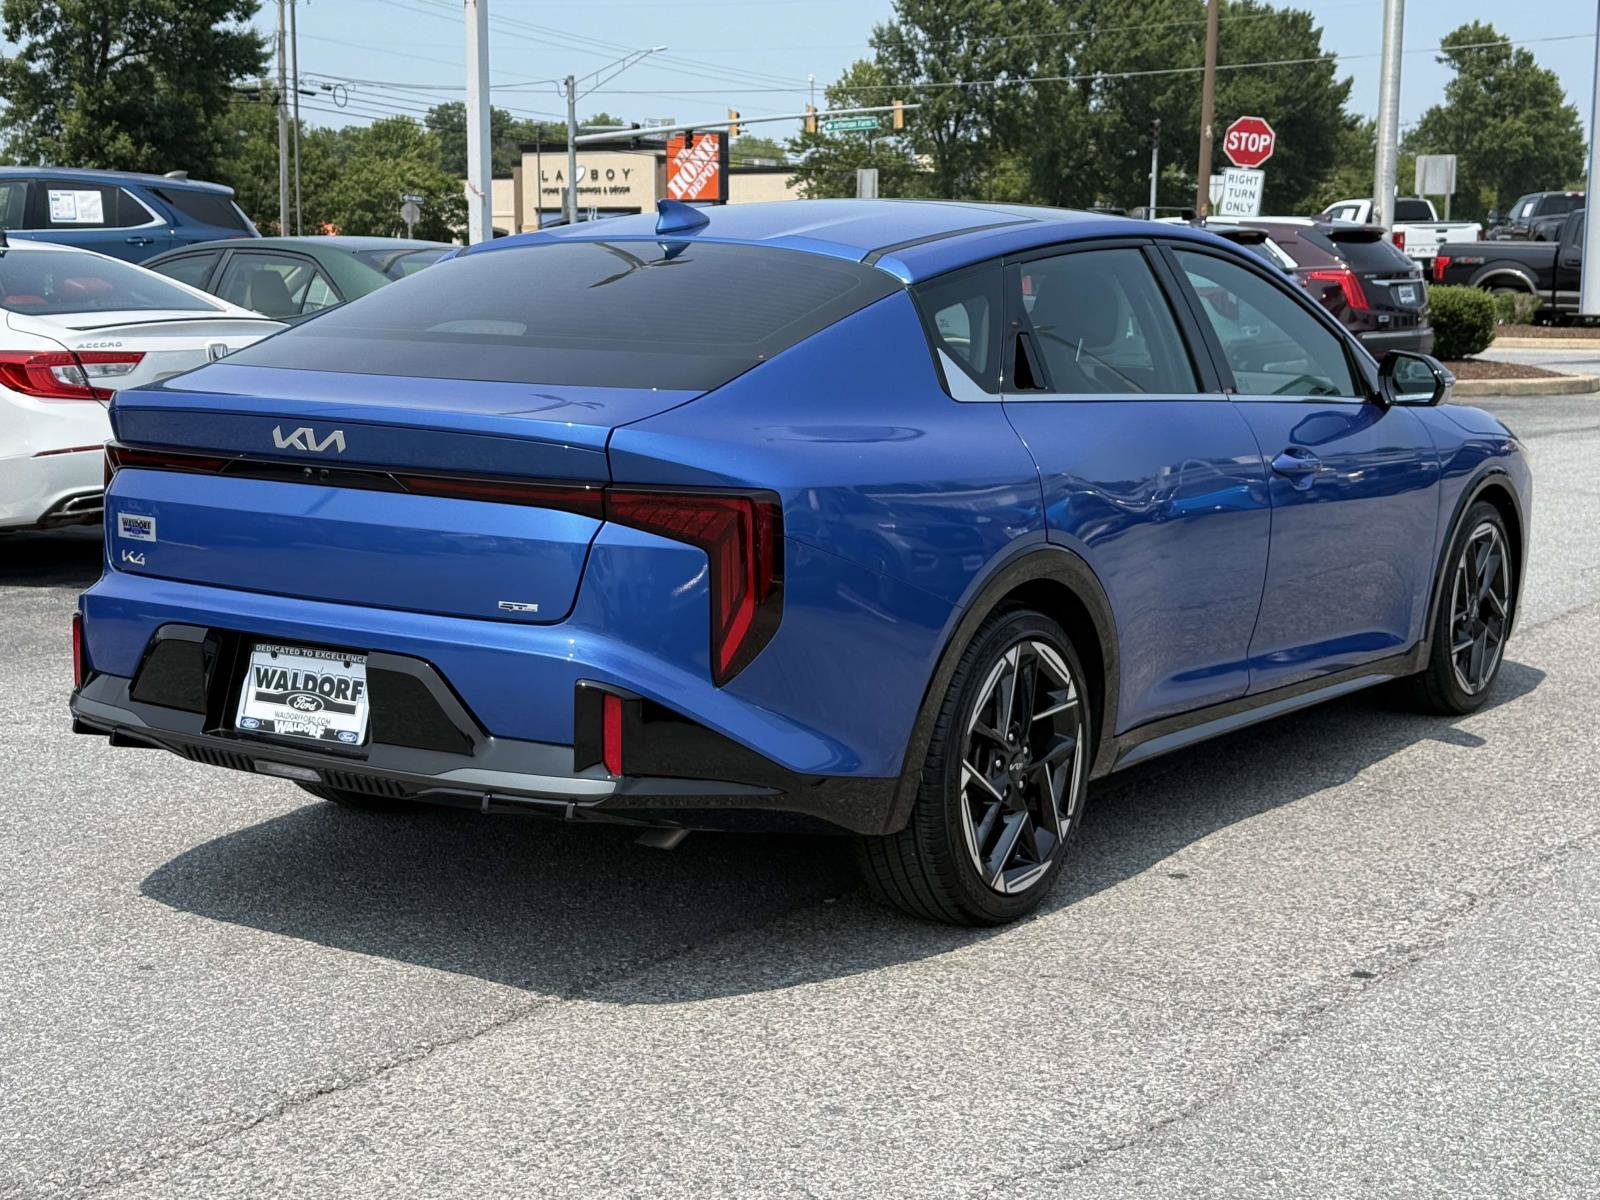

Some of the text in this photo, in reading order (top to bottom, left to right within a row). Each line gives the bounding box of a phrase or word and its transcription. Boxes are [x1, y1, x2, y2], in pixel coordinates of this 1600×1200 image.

[1228, 131, 1270, 153] STOP
[666, 134, 720, 200] HOME
[687, 161, 720, 200] DEPOT
[1228, 173, 1259, 187] RIGHT
[1228, 187, 1256, 200] TURN
[1225, 201, 1254, 213] ONLY
[77, 341, 122, 349] ACCORD
[121, 517, 152, 530] WALDORF
[121, 549, 146, 566] K4
[255, 644, 368, 663] DEDICATED TO EXCELLENCE
[254, 666, 365, 702] WALDORF
[292, 695, 318, 711] Ford
[274, 719, 326, 739] WALDORF
